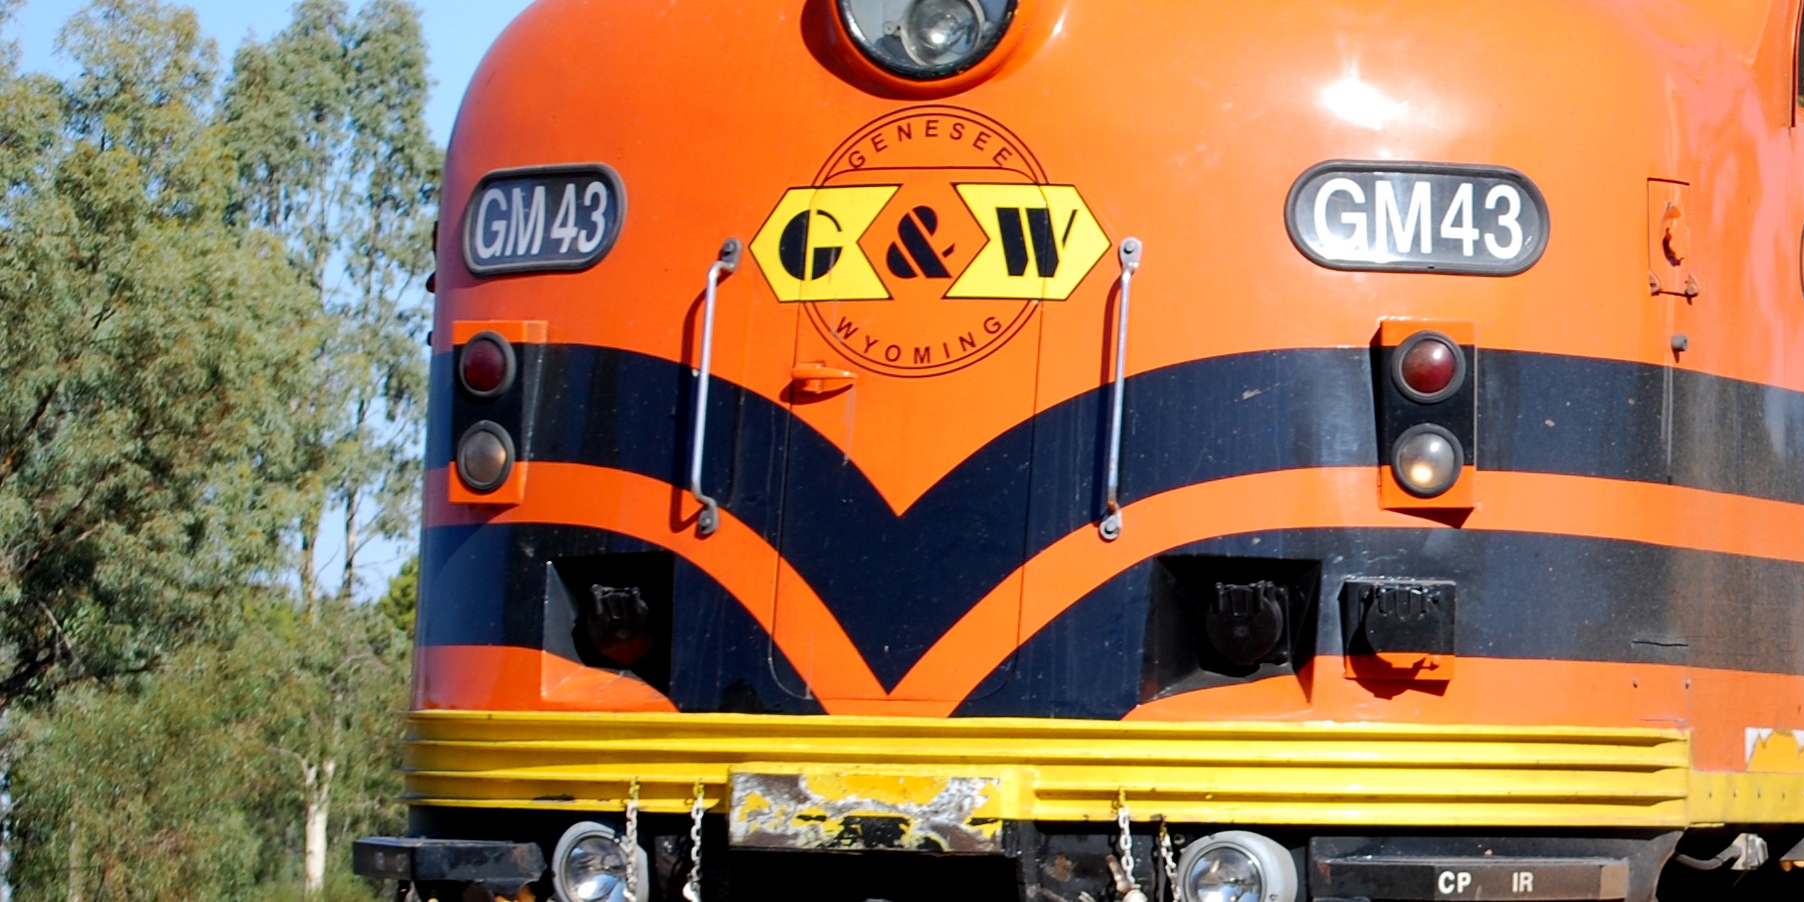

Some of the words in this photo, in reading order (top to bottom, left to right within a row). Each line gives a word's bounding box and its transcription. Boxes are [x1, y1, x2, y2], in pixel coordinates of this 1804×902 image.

[848, 119, 1012, 169] GENESEE
[836, 315, 1002, 364] WYOMING
[1438, 870, 1472, 894] CP
[1512, 871, 1534, 892] IR
